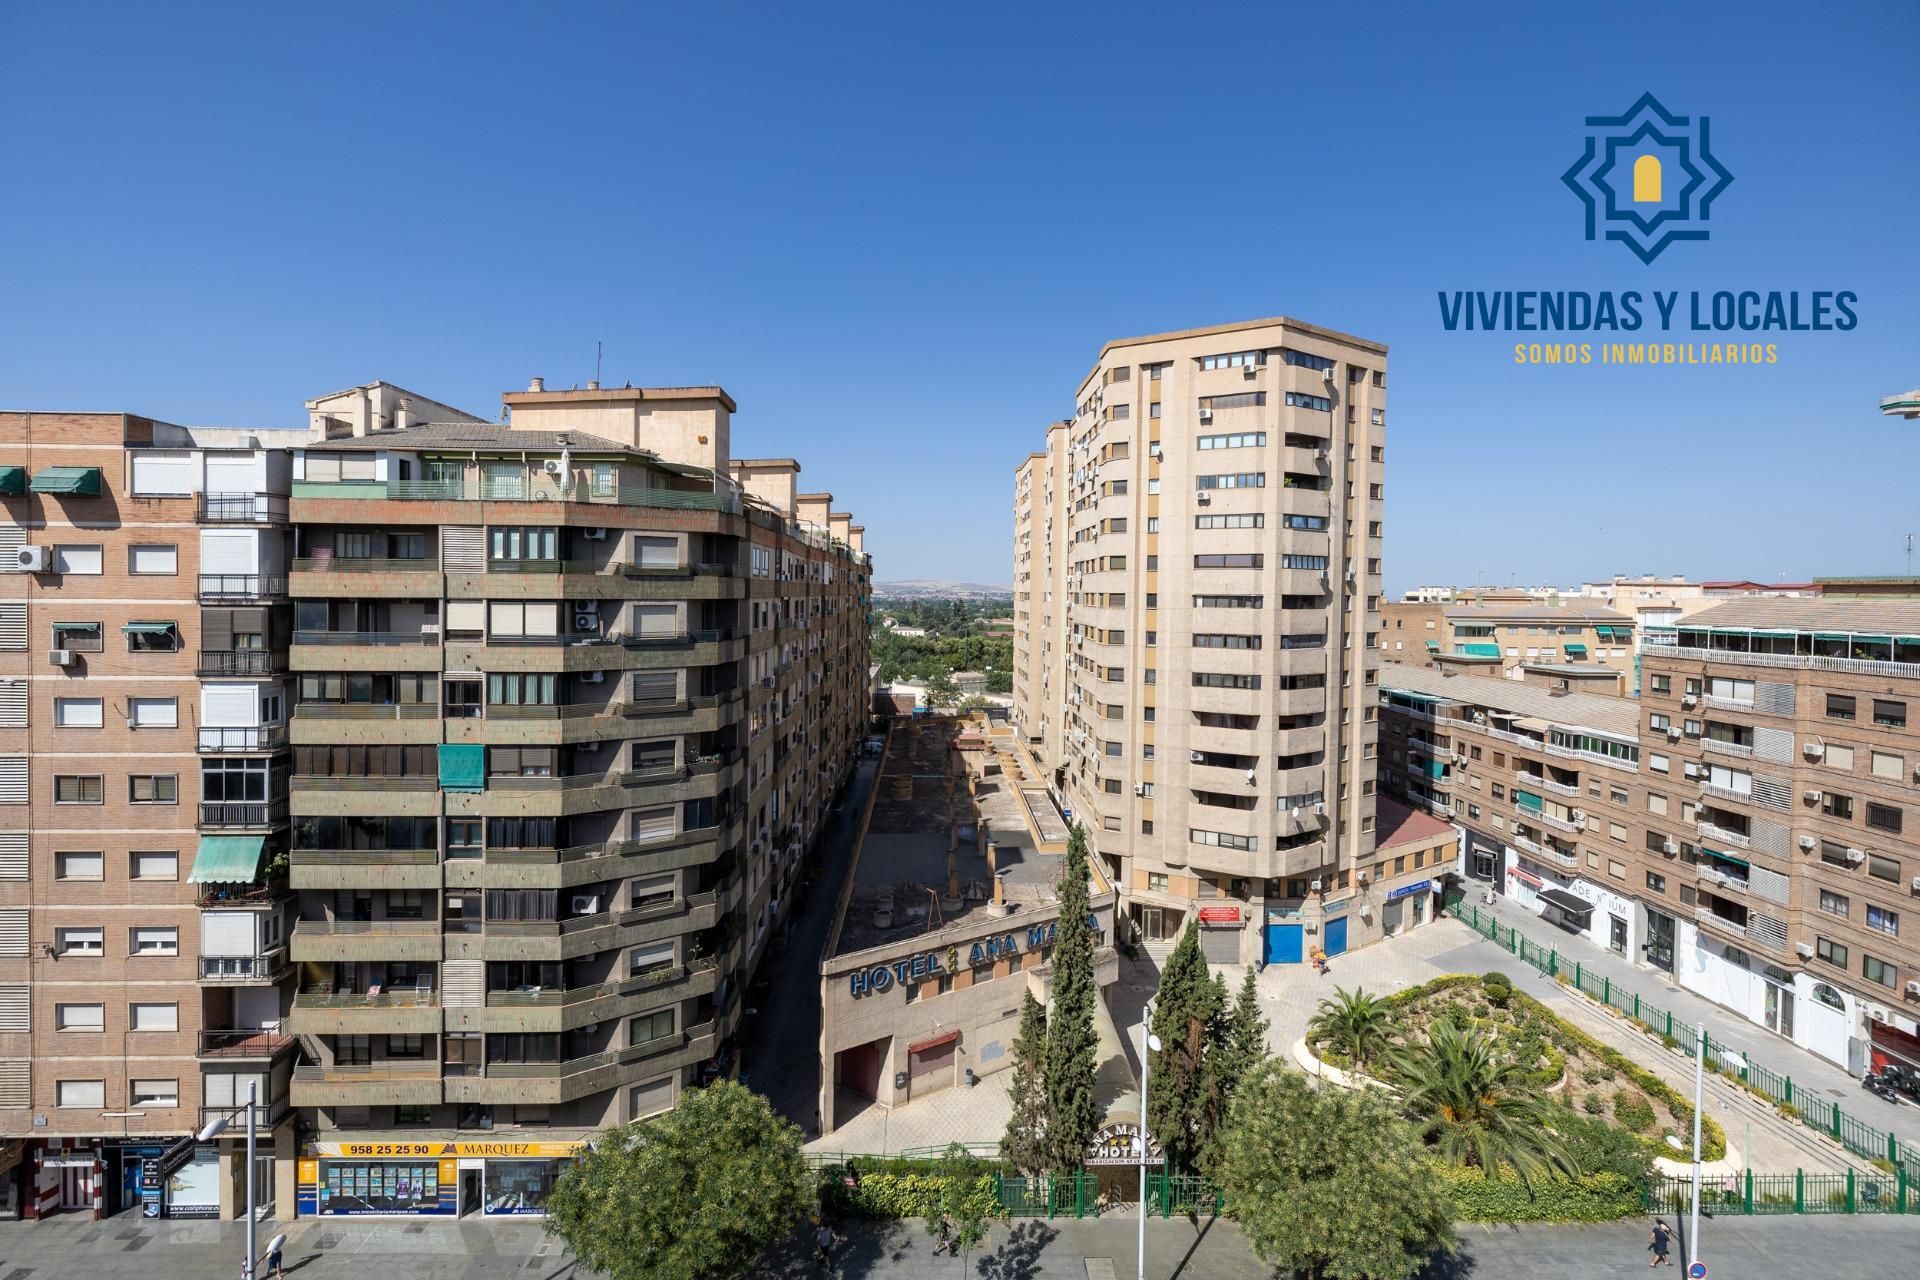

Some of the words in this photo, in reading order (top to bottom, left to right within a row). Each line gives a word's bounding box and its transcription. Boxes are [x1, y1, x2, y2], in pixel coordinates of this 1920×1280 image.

[850, 953, 943, 996] HOTEL
[968, 933, 1018, 965] ANA
[1026, 913, 1099, 949] MAA
[350, 1145, 372, 1155] 958
[376, 1145, 392, 1155] 25
[395, 1145, 410, 1155] 25
[414, 1145, 429, 1155] 90
[464, 1144, 529, 1156] MARQUEZ
[1099, 1146, 1149, 1157] HOTE
